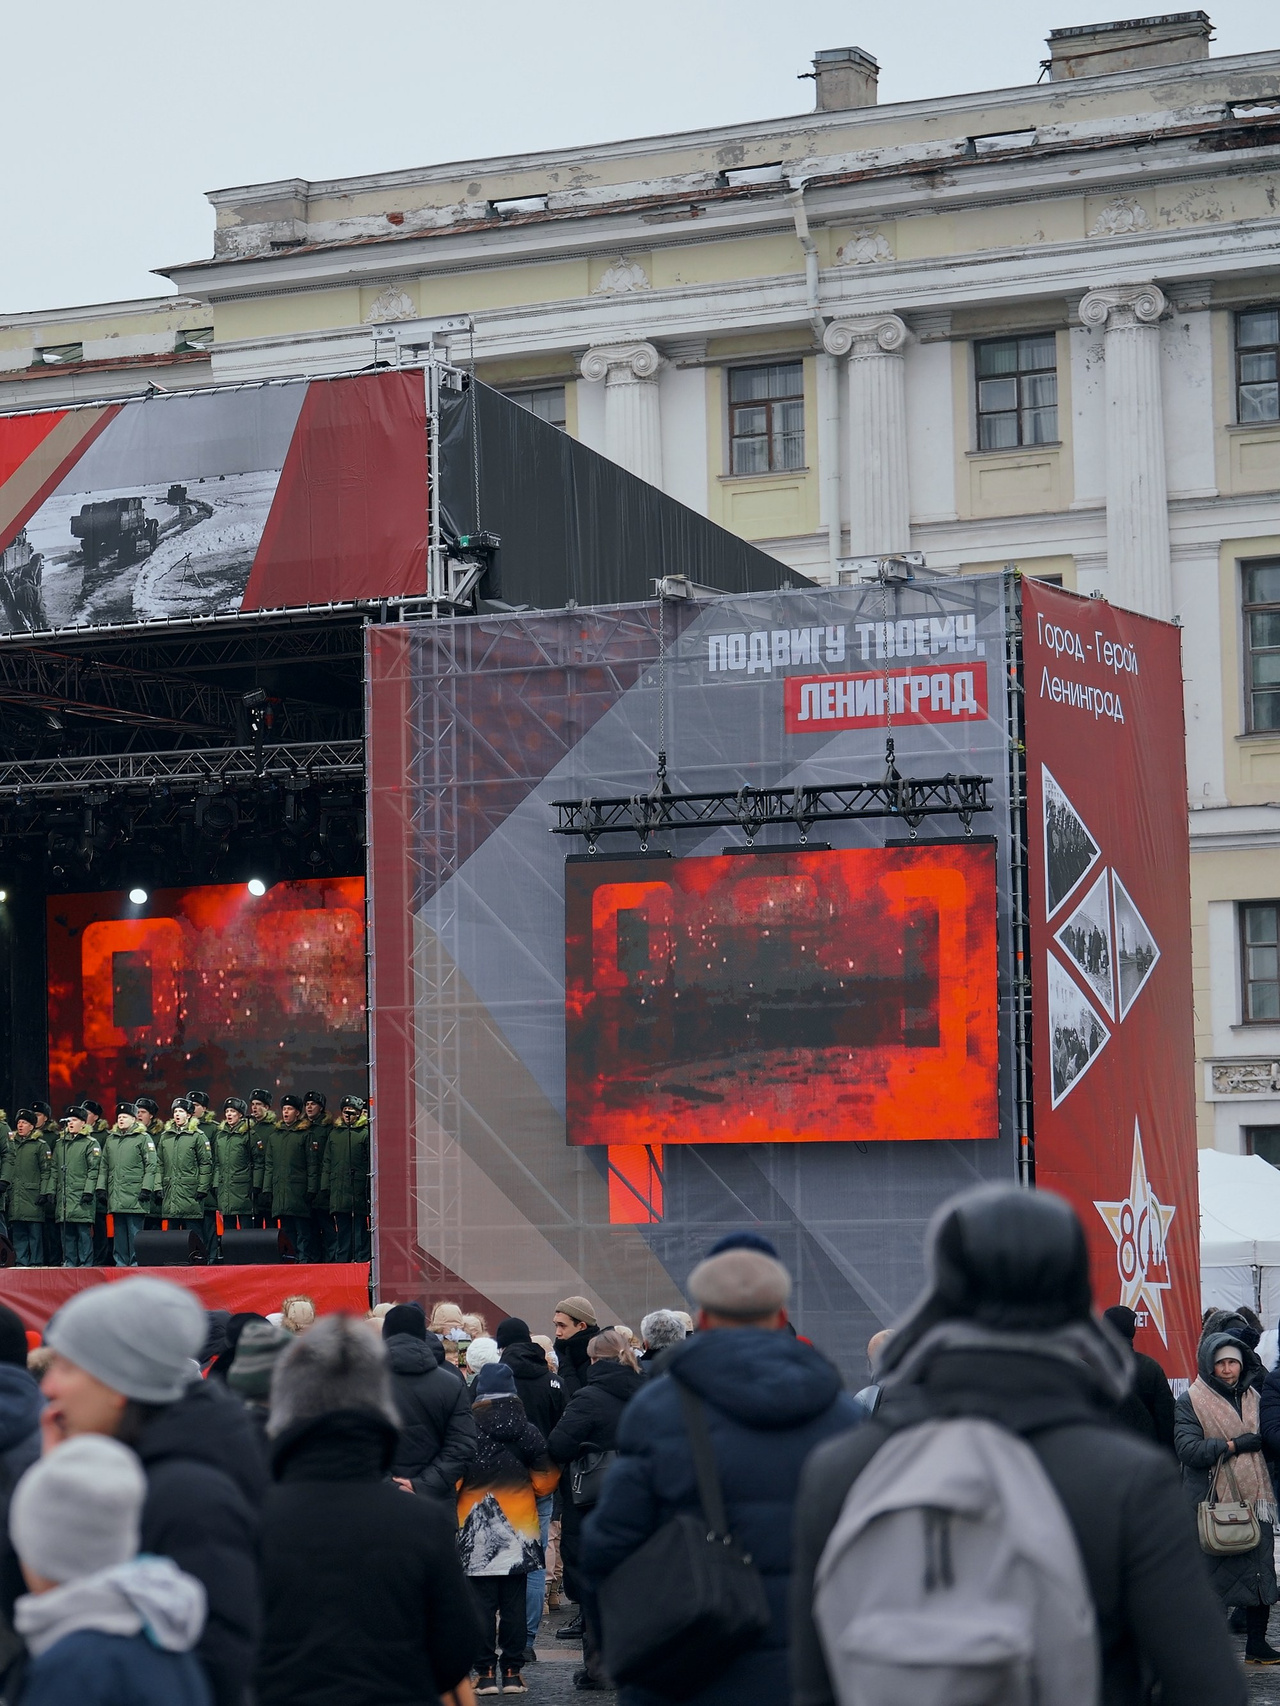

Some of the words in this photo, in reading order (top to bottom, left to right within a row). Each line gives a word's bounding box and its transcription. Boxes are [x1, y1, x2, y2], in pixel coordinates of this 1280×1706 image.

[708, 625, 846, 674] ПОДВИГУ
[1037, 612, 1085, 664] Город
[1094, 630, 1139, 676] Герой
[797, 671, 977, 721] ЛЕНИНГРАД
[1039, 665, 1125, 725] Ленинград
